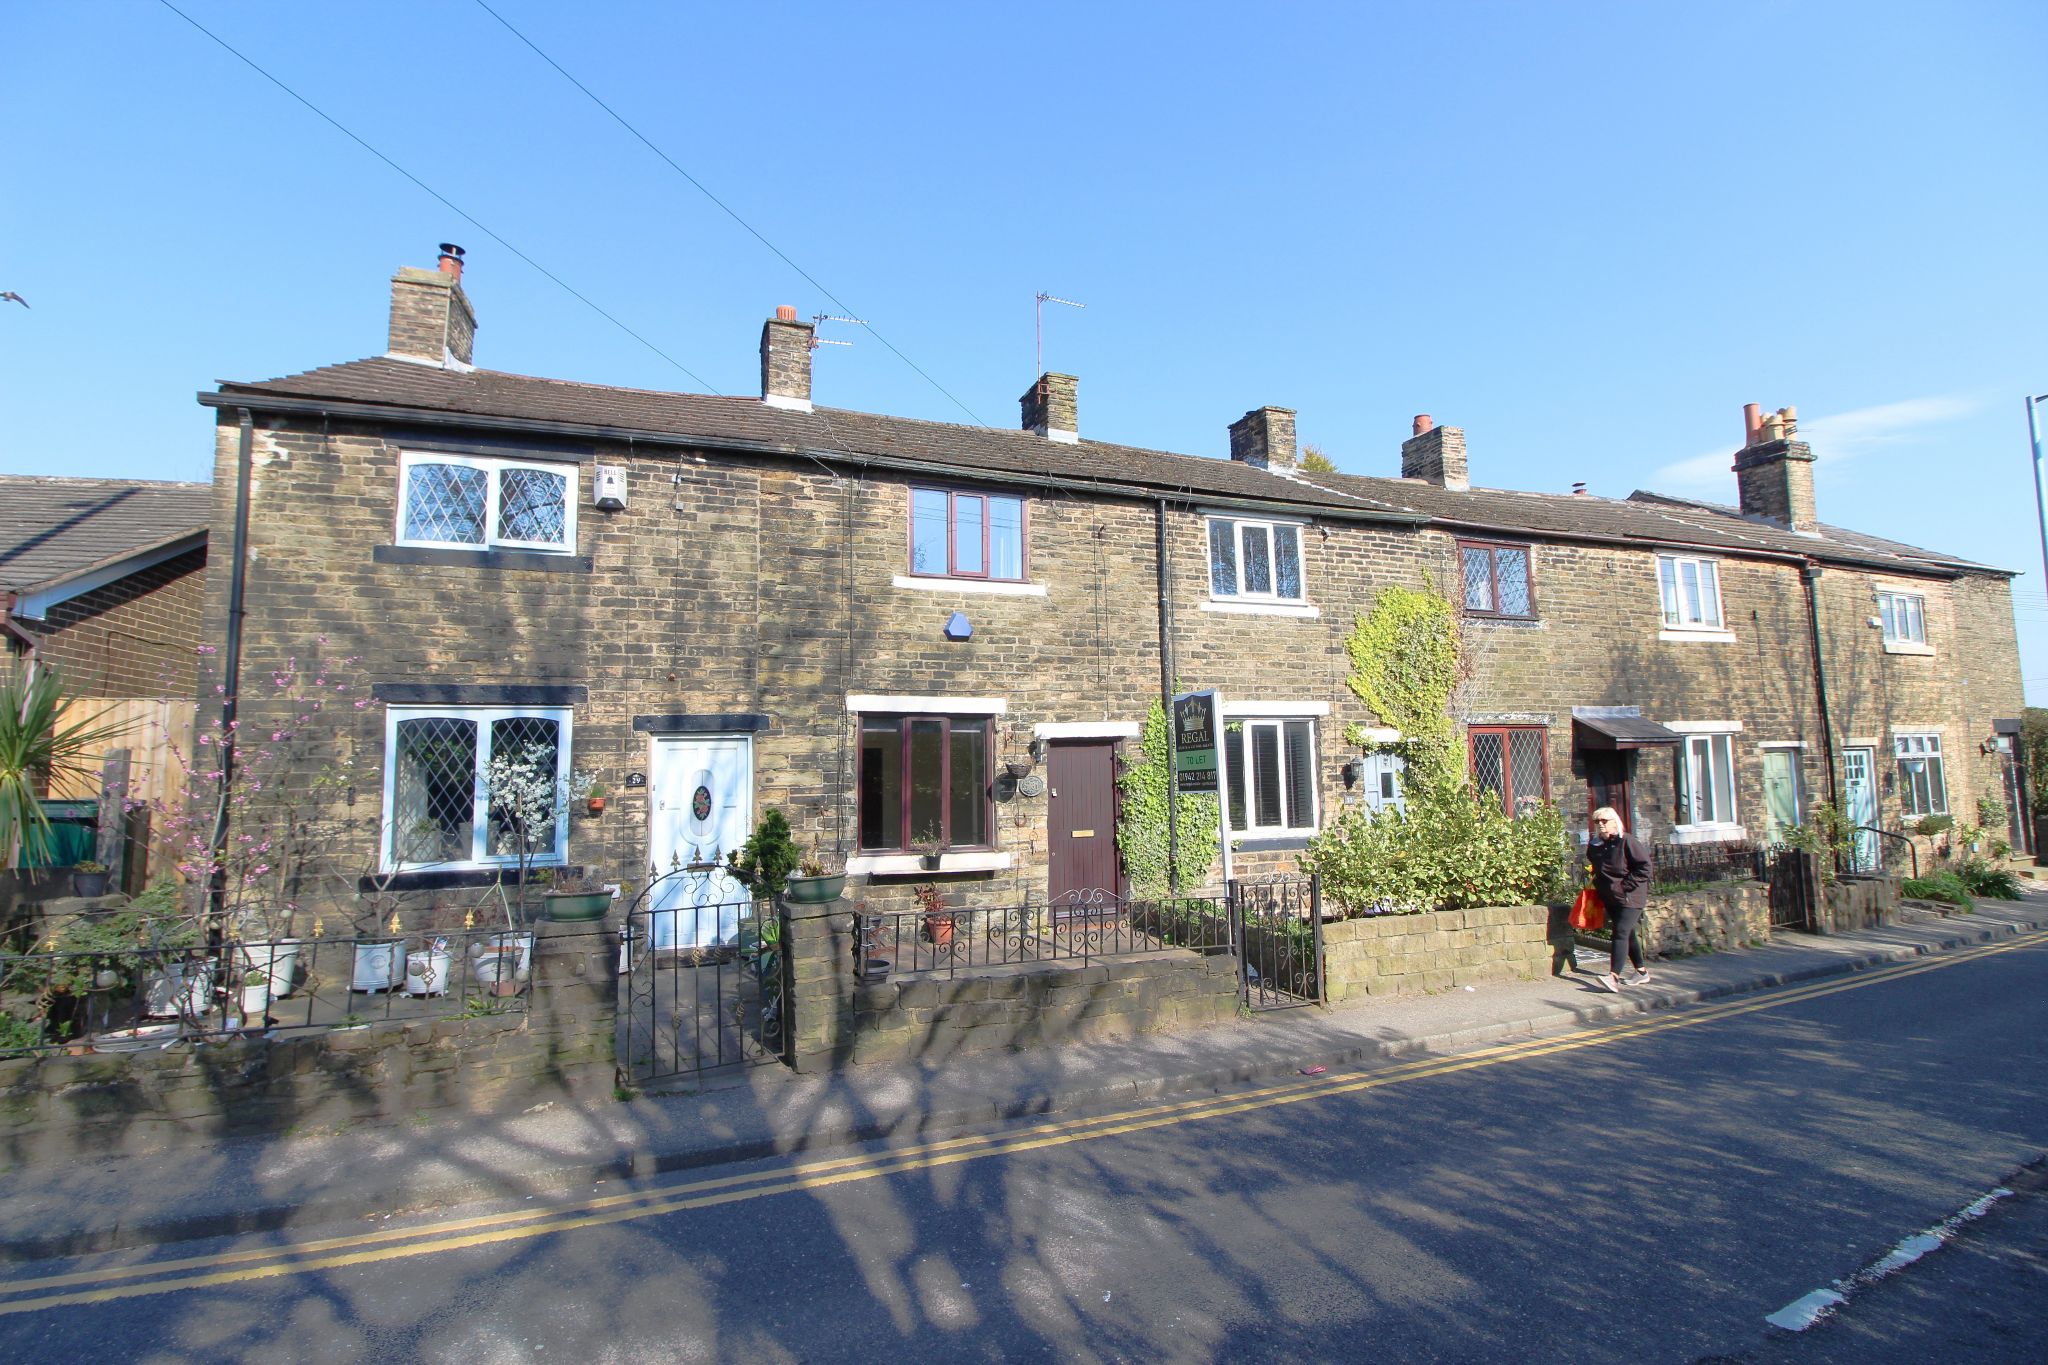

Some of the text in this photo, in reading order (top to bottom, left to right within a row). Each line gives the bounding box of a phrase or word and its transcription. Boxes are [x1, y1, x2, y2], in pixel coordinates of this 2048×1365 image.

[1181, 730, 1210, 744] REGAL
[1186, 755, 1206, 765] TO LET
[1179, 771, 1216, 781] 01942 214 817
